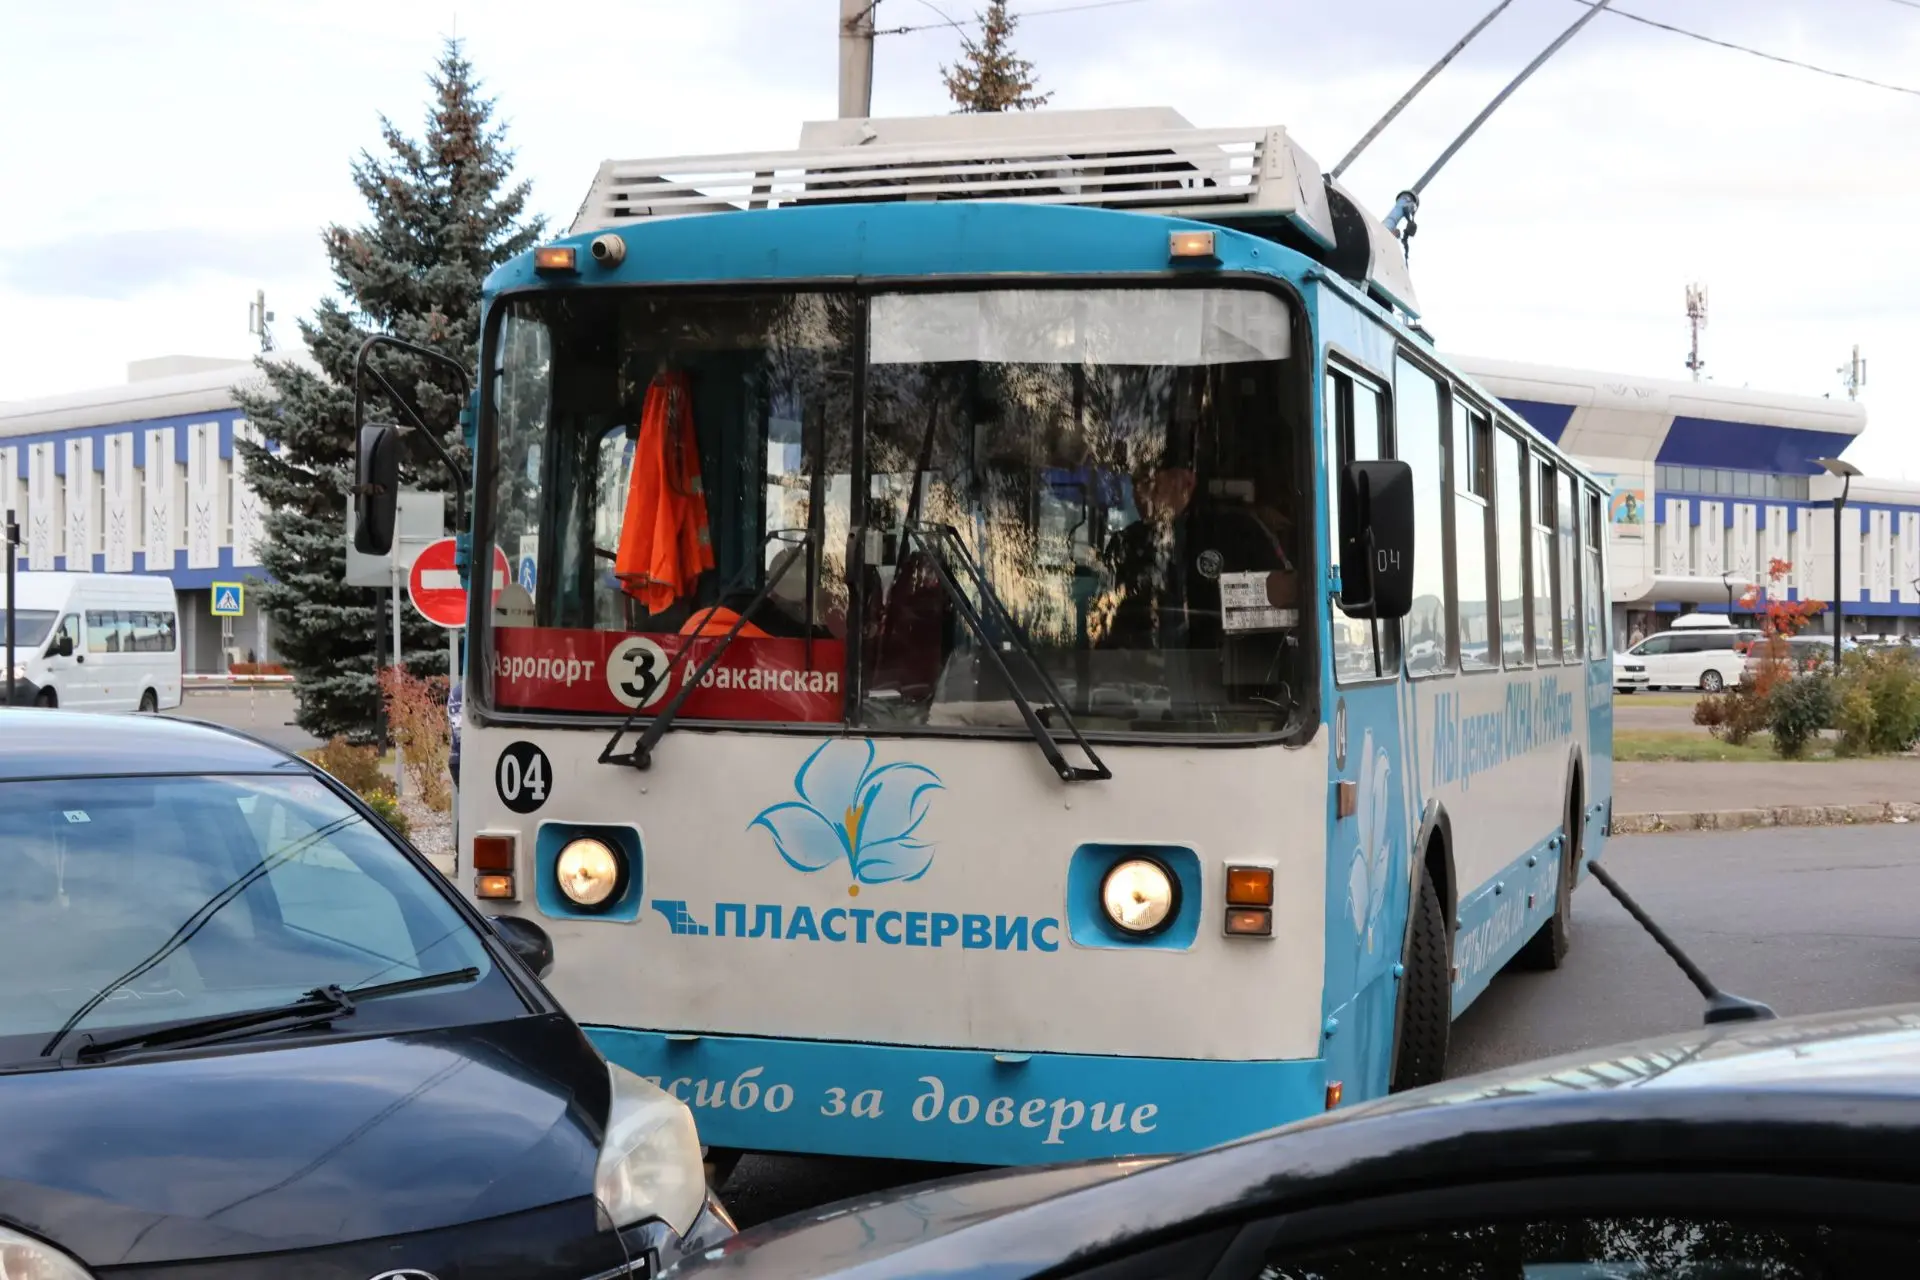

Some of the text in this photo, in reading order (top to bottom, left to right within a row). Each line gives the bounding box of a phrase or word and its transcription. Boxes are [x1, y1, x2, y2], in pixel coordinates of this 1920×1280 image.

[1377, 550, 1400, 573] 04
[491, 651, 595, 687] Аэропорт
[620, 647, 656, 699] 3
[1505, 681, 1532, 761] ОКНА
[501, 753, 546, 801] 04
[714, 903, 1059, 952] ПЛАСТСЕРВИС
[820, 1086, 884, 1119] за
[911, 1076, 1158, 1145] доверие
